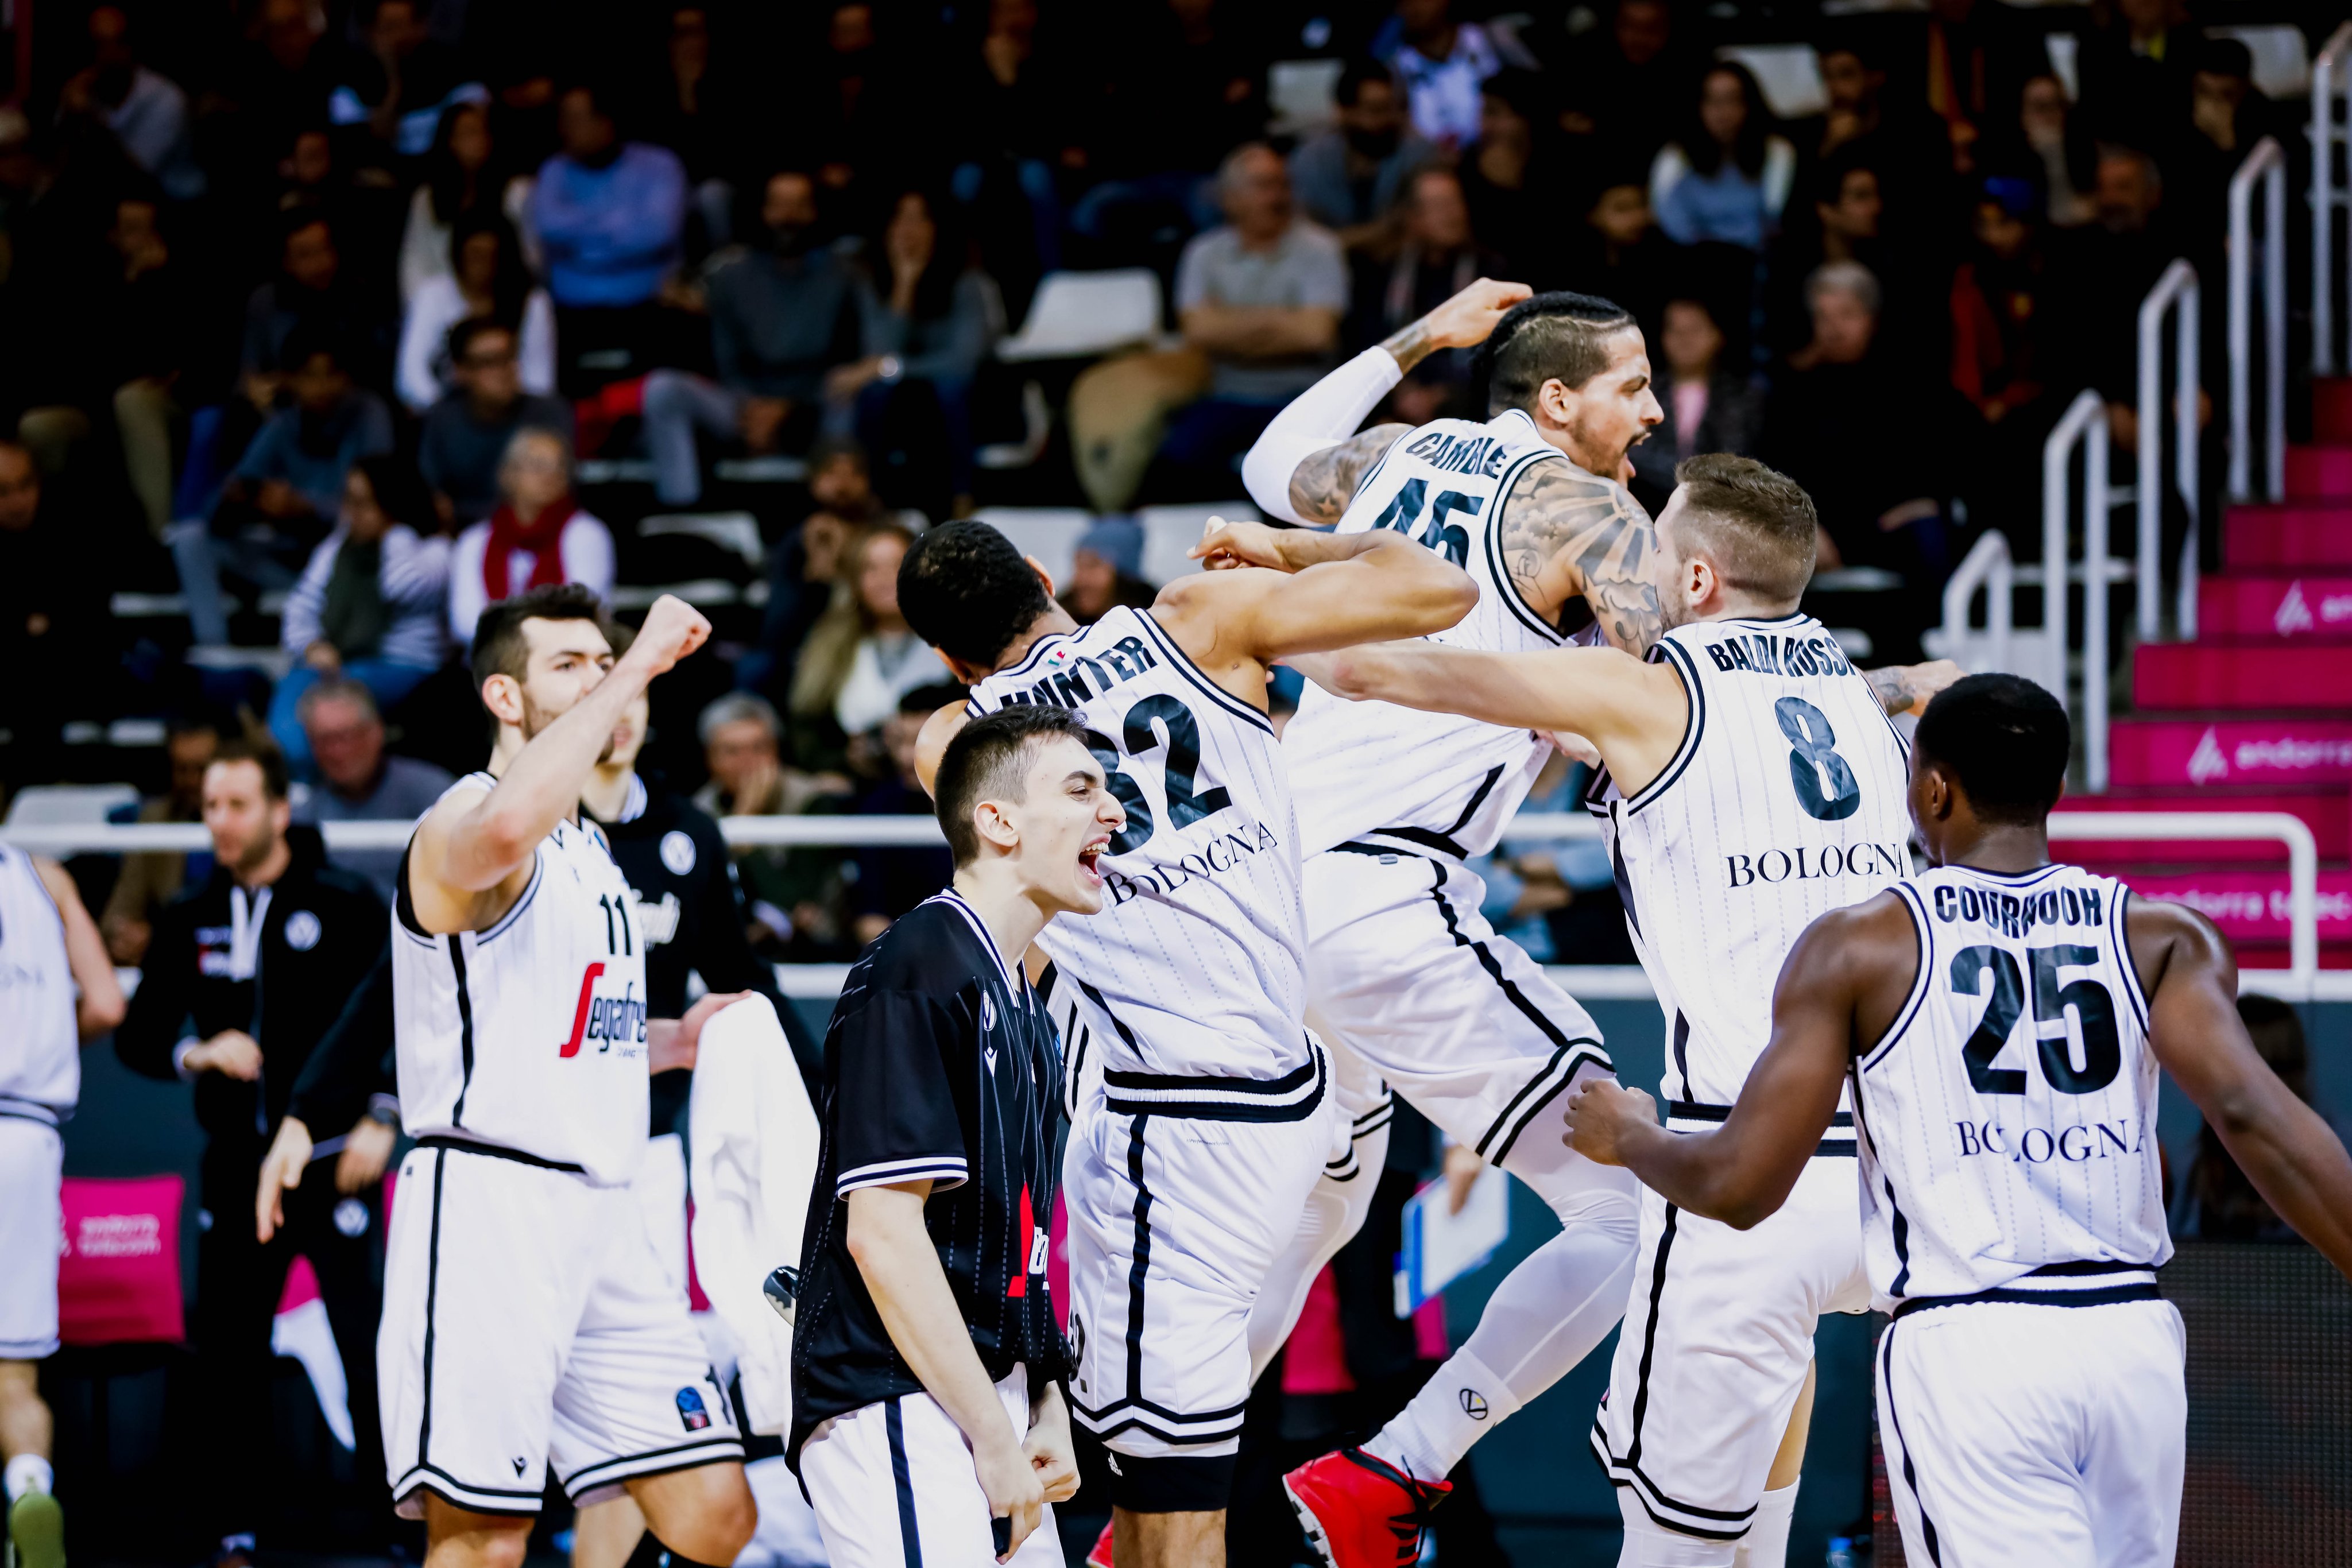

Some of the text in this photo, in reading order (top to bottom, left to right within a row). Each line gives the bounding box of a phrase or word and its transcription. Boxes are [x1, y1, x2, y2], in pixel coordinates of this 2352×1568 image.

[1775, 696, 1860, 820] 8
[600, 894, 631, 955] 11
[1950, 944, 2121, 1095] 25
[1953, 1120, 2145, 1163] BOOGN
